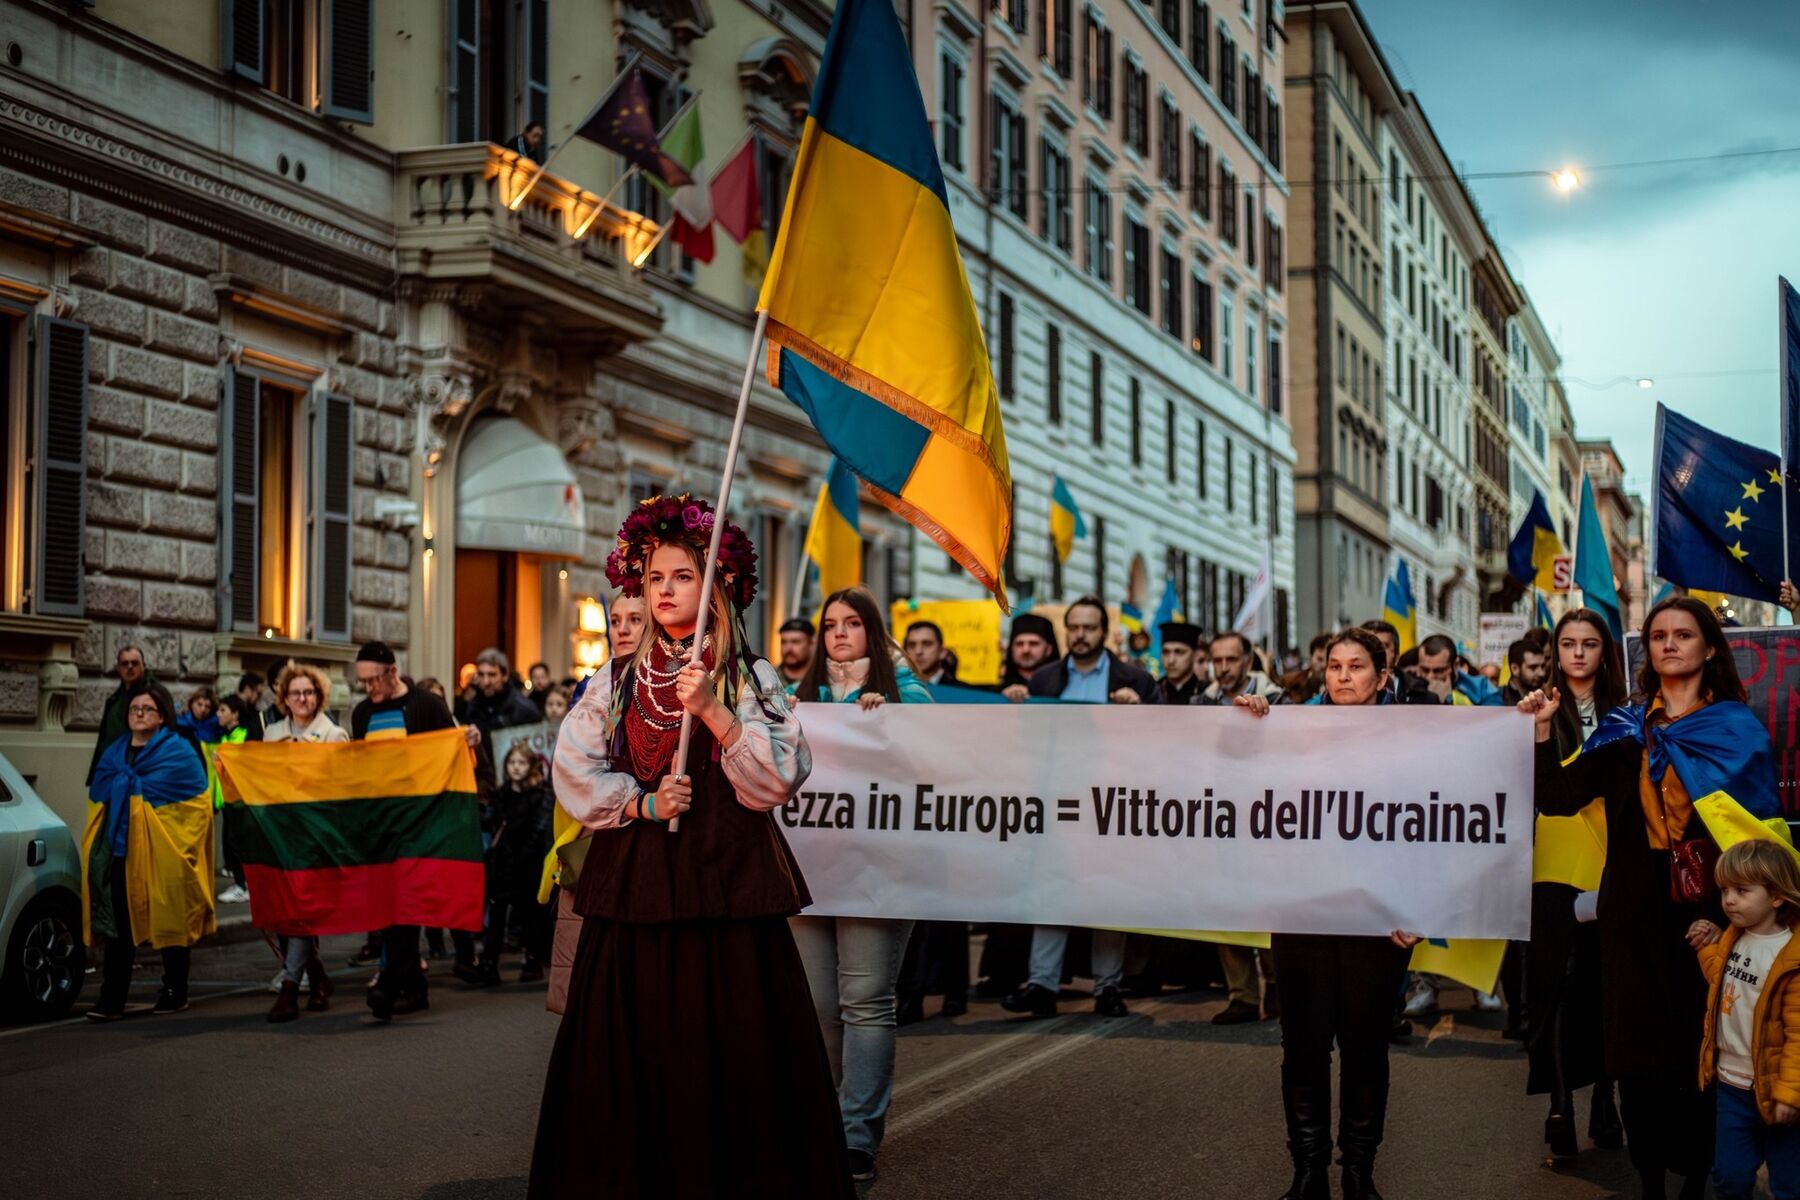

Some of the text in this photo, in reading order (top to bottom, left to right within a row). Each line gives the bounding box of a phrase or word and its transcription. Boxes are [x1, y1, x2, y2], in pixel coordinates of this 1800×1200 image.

[1554, 561, 1570, 588] S
[1728, 637, 1800, 686] OP
[780, 782, 1507, 845] ezza in Europa = Vittoria dell'Ucraina!
[1725, 965, 1758, 985] РАЇНИ
